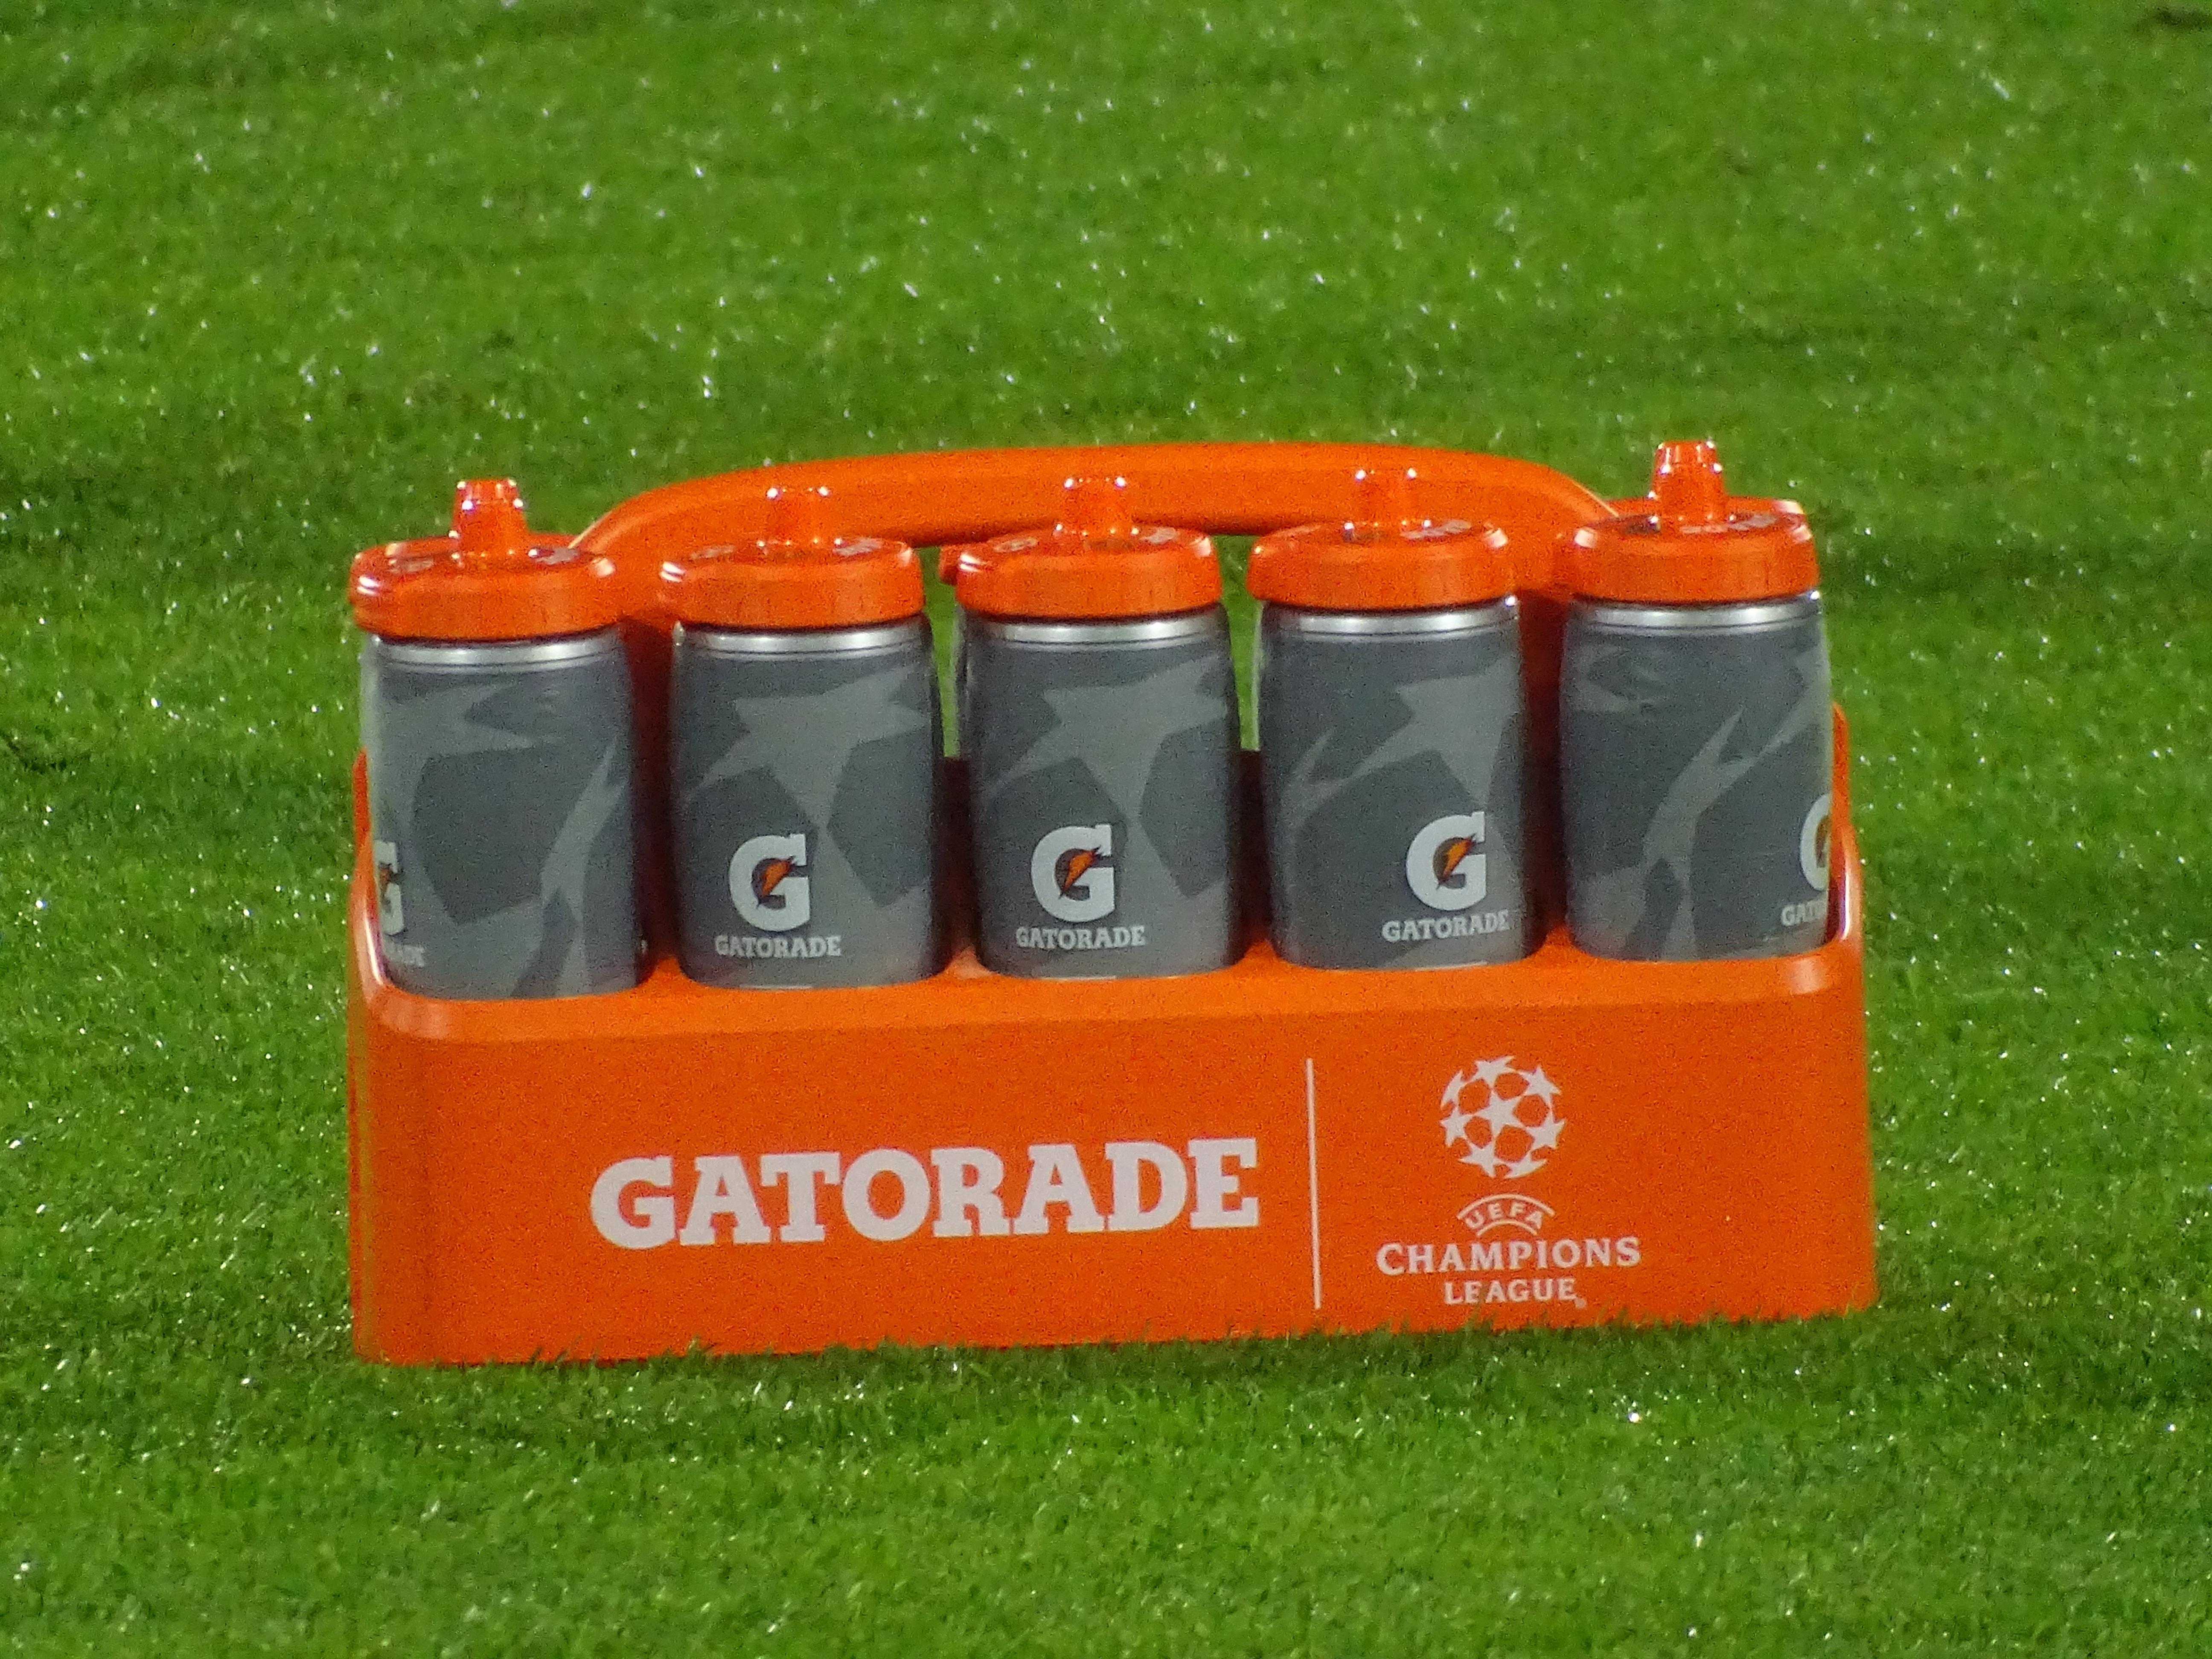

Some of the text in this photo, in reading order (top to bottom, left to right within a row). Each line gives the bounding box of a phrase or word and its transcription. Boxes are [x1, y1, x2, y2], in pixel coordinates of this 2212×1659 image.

[1030, 824, 1115, 922] G
[1406, 811, 1487, 911] G
[728, 833, 810, 931] G
[1016, 925, 1146, 950] GATORADE
[1382, 908, 1510, 941] GATORADE
[714, 934, 842, 958] GATORADE
[591, 1137, 1258, 1249] GATORADE
[1465, 1201, 1543, 1229] UEFA
[1376, 1237, 1640, 1275] CHAMPIONS
[1445, 1278, 1577, 1304] LEAGUE
